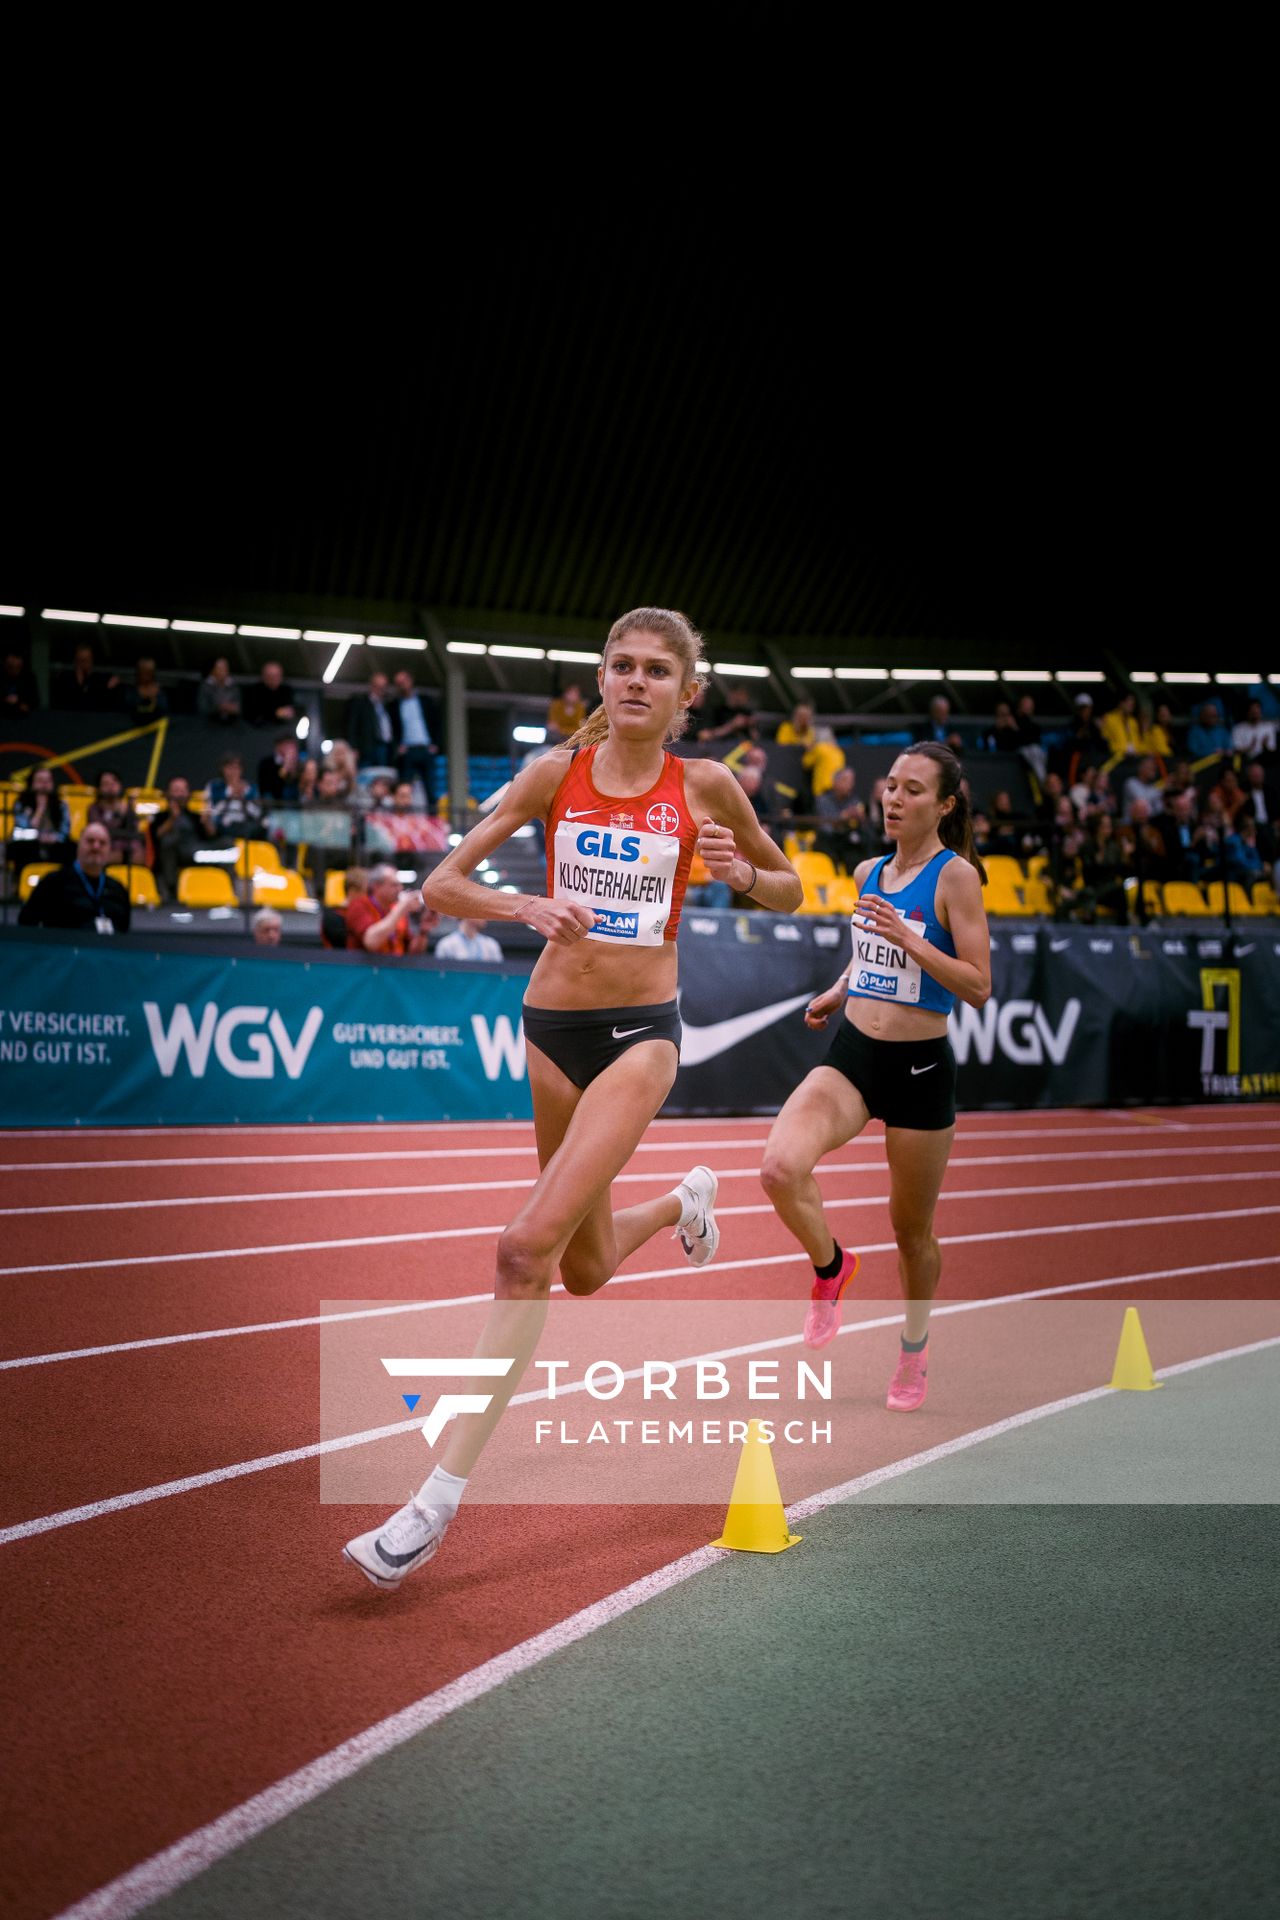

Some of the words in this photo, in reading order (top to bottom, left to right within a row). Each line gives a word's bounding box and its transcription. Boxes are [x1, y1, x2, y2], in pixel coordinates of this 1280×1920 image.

[560, 861, 667, 904] KLOSTERHALFEN
[857, 940, 907, 969] KLEIN
[869, 976, 896, 989] PLAN
[9, 1010, 130, 1037] VERSICHERT.
[332, 1022, 368, 1043] GUT
[367, 1024, 463, 1046] VERSICHERT.
[947, 997, 1082, 1065] WGV
[0, 1040, 28, 1062] ND
[33, 1041, 72, 1063] GUT
[77, 1042, 111, 1065] IST.
[143, 1001, 324, 1079] WGV
[350, 1049, 384, 1069] UND
[386, 1049, 419, 1069] GUT
[422, 1050, 450, 1070] IST.
